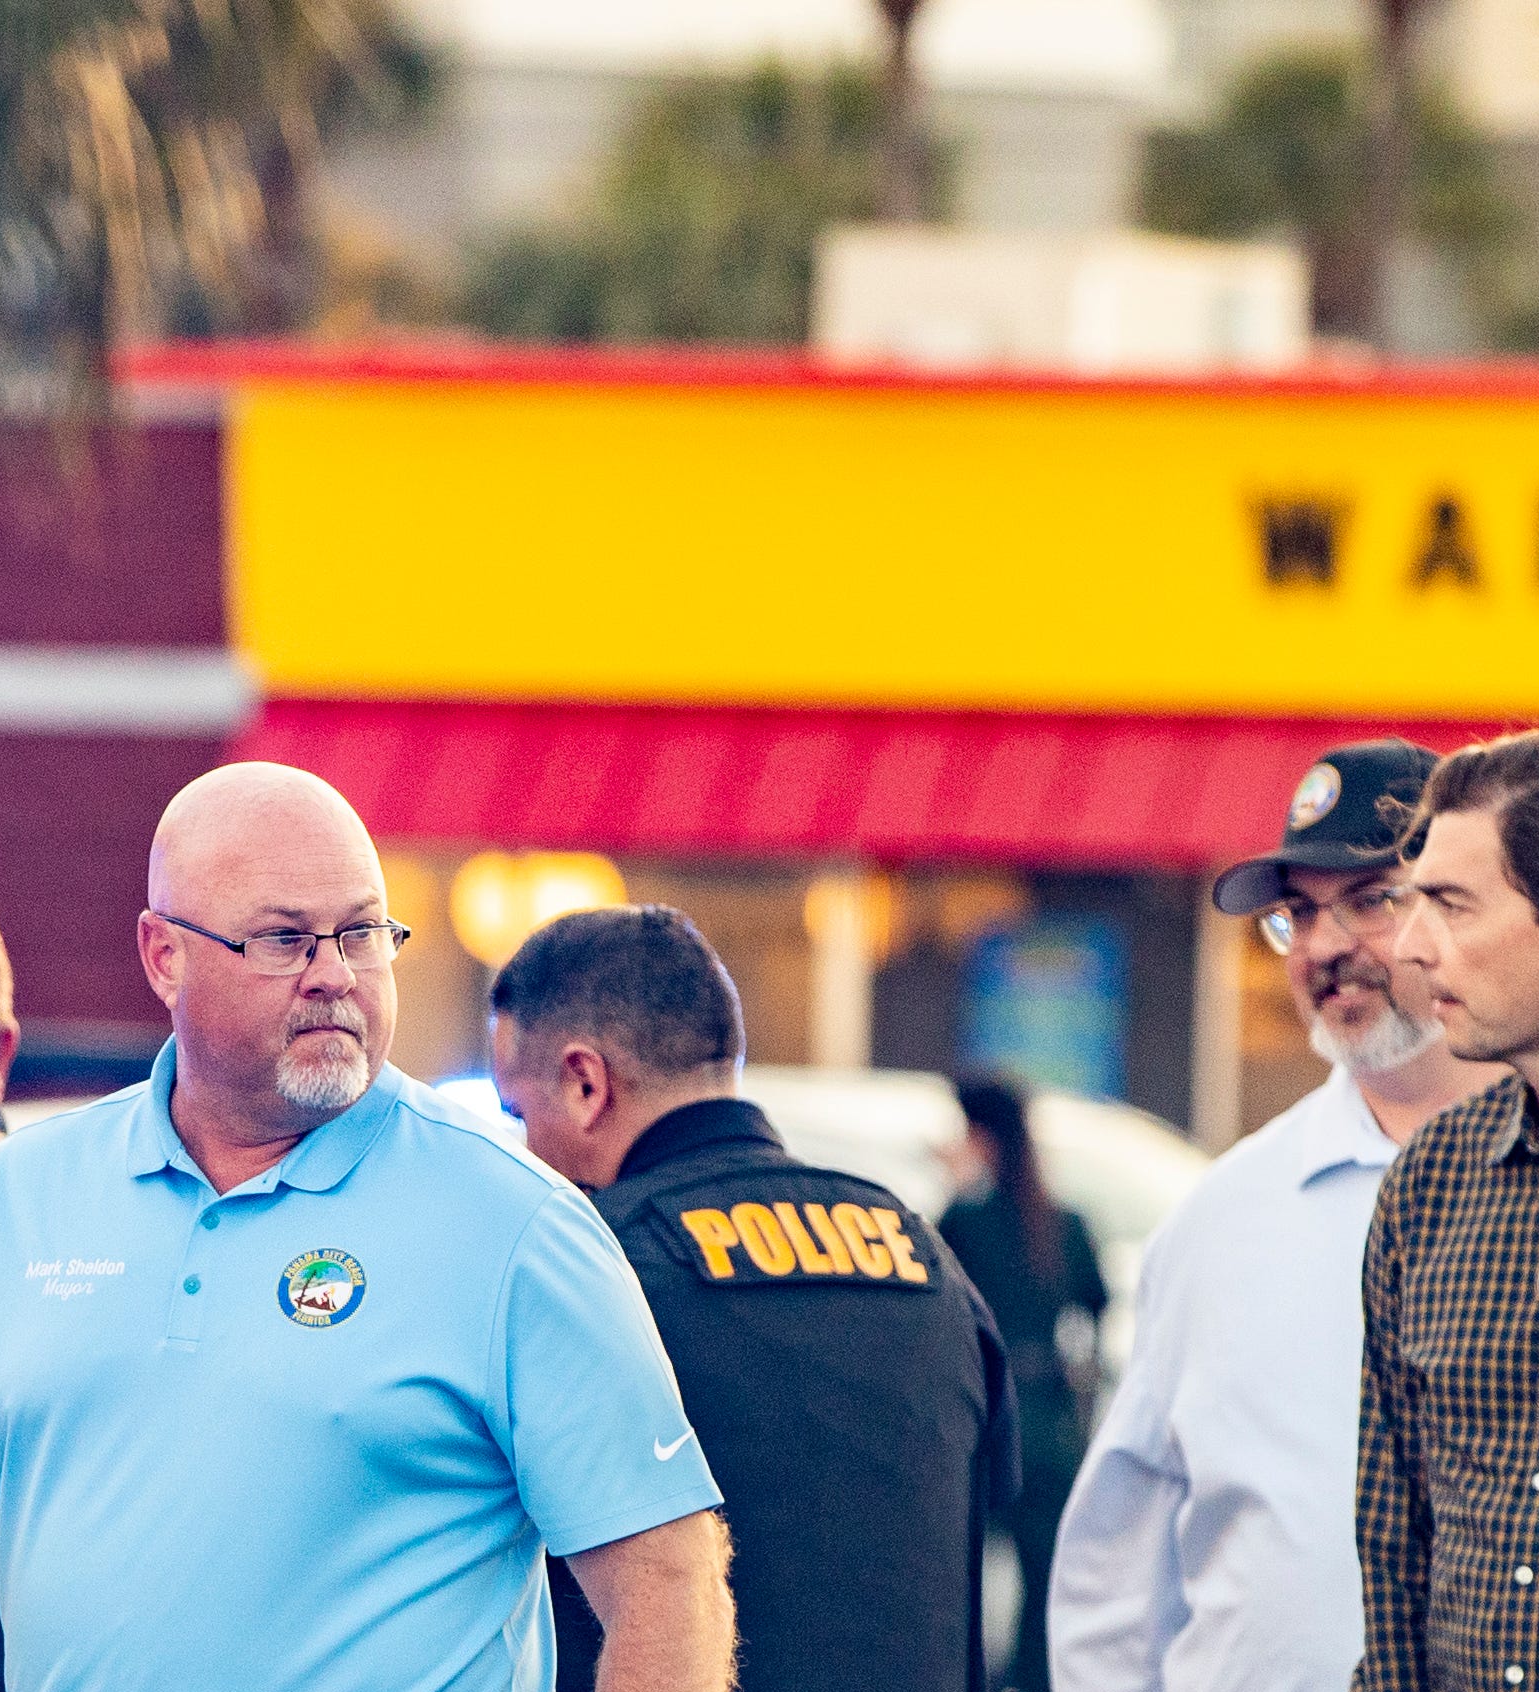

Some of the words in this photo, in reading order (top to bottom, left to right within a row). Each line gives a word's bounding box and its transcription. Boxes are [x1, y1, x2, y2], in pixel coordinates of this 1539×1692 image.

[679, 1201, 929, 1285] POLICE
[24, 1259, 64, 1280] Mark
[65, 1257, 126, 1277] Sheldon
[42, 1277, 94, 1301] Mayor
